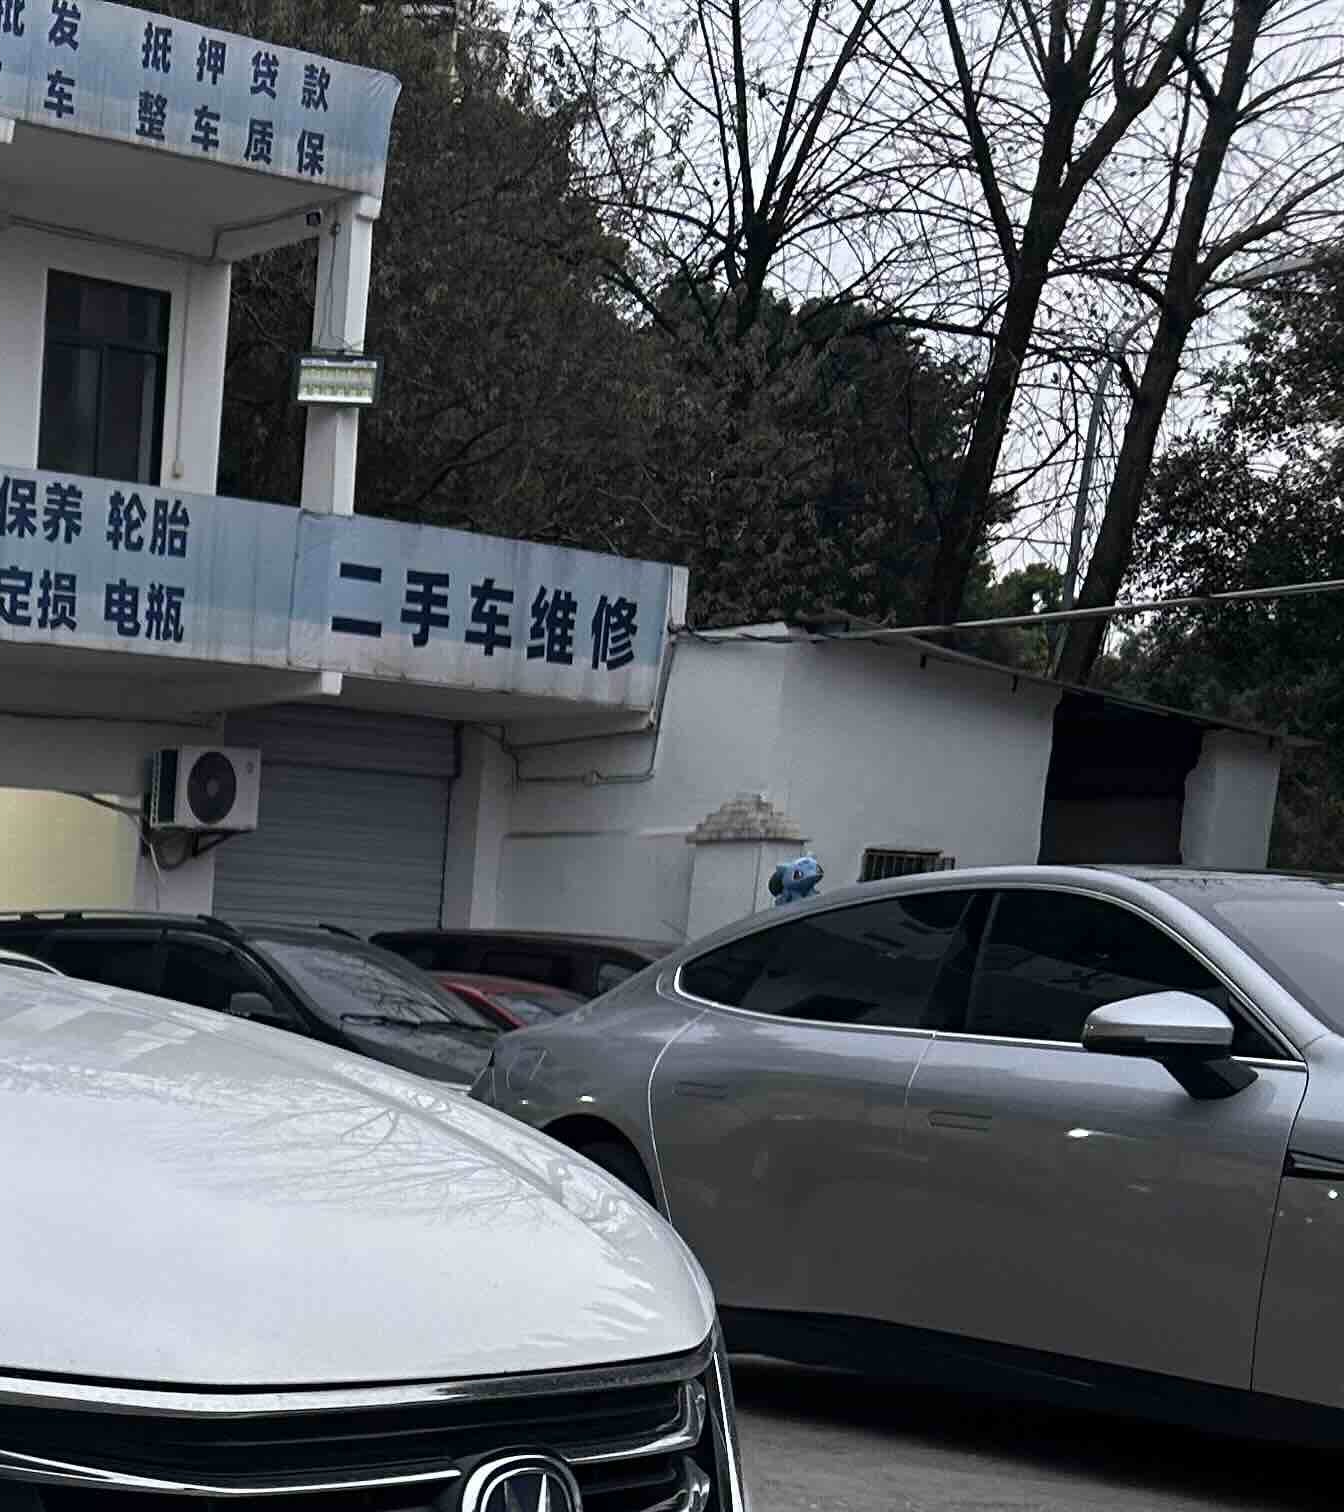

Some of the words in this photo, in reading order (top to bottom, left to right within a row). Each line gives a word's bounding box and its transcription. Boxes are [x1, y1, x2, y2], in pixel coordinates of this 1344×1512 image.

[141, 21, 329, 112] 抵押贷款
[135, 90, 325, 176] 整车质保
[105, 490, 190, 559] 轮胎
[103, 577, 186, 643] 电瓶
[330, 561, 638, 671] 二手车维修
